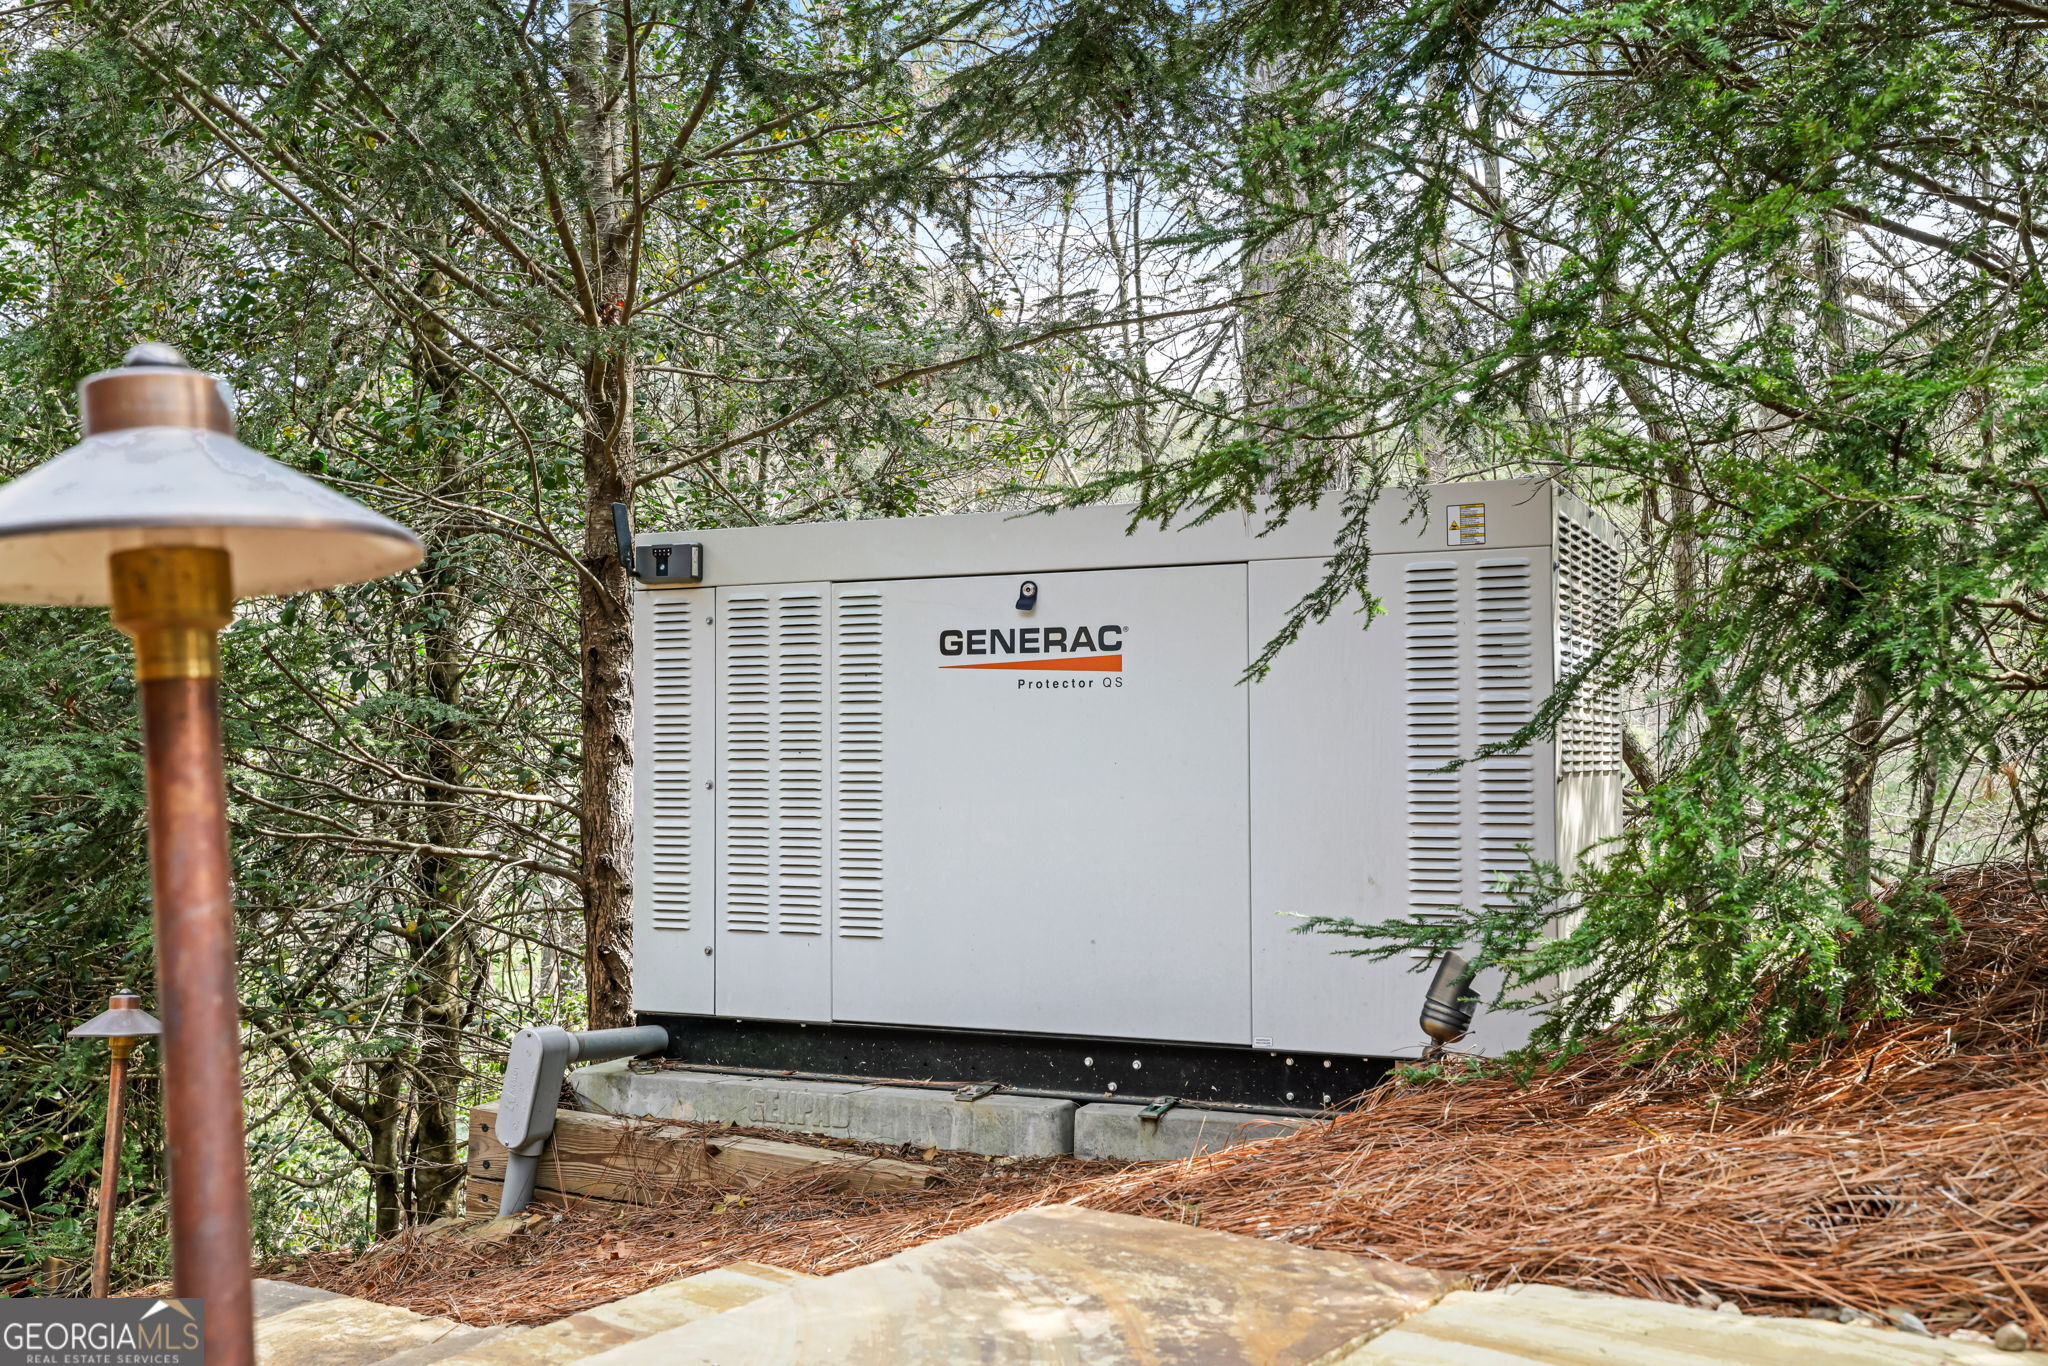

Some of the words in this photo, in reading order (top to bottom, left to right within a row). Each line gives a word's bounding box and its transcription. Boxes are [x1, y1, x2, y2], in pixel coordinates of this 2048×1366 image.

[939, 624, 1123, 656] GENERAC
[1017, 678, 1094, 689] Protector
[1102, 676, 1123, 688] QS
[748, 1087, 850, 1128] GENPAD
